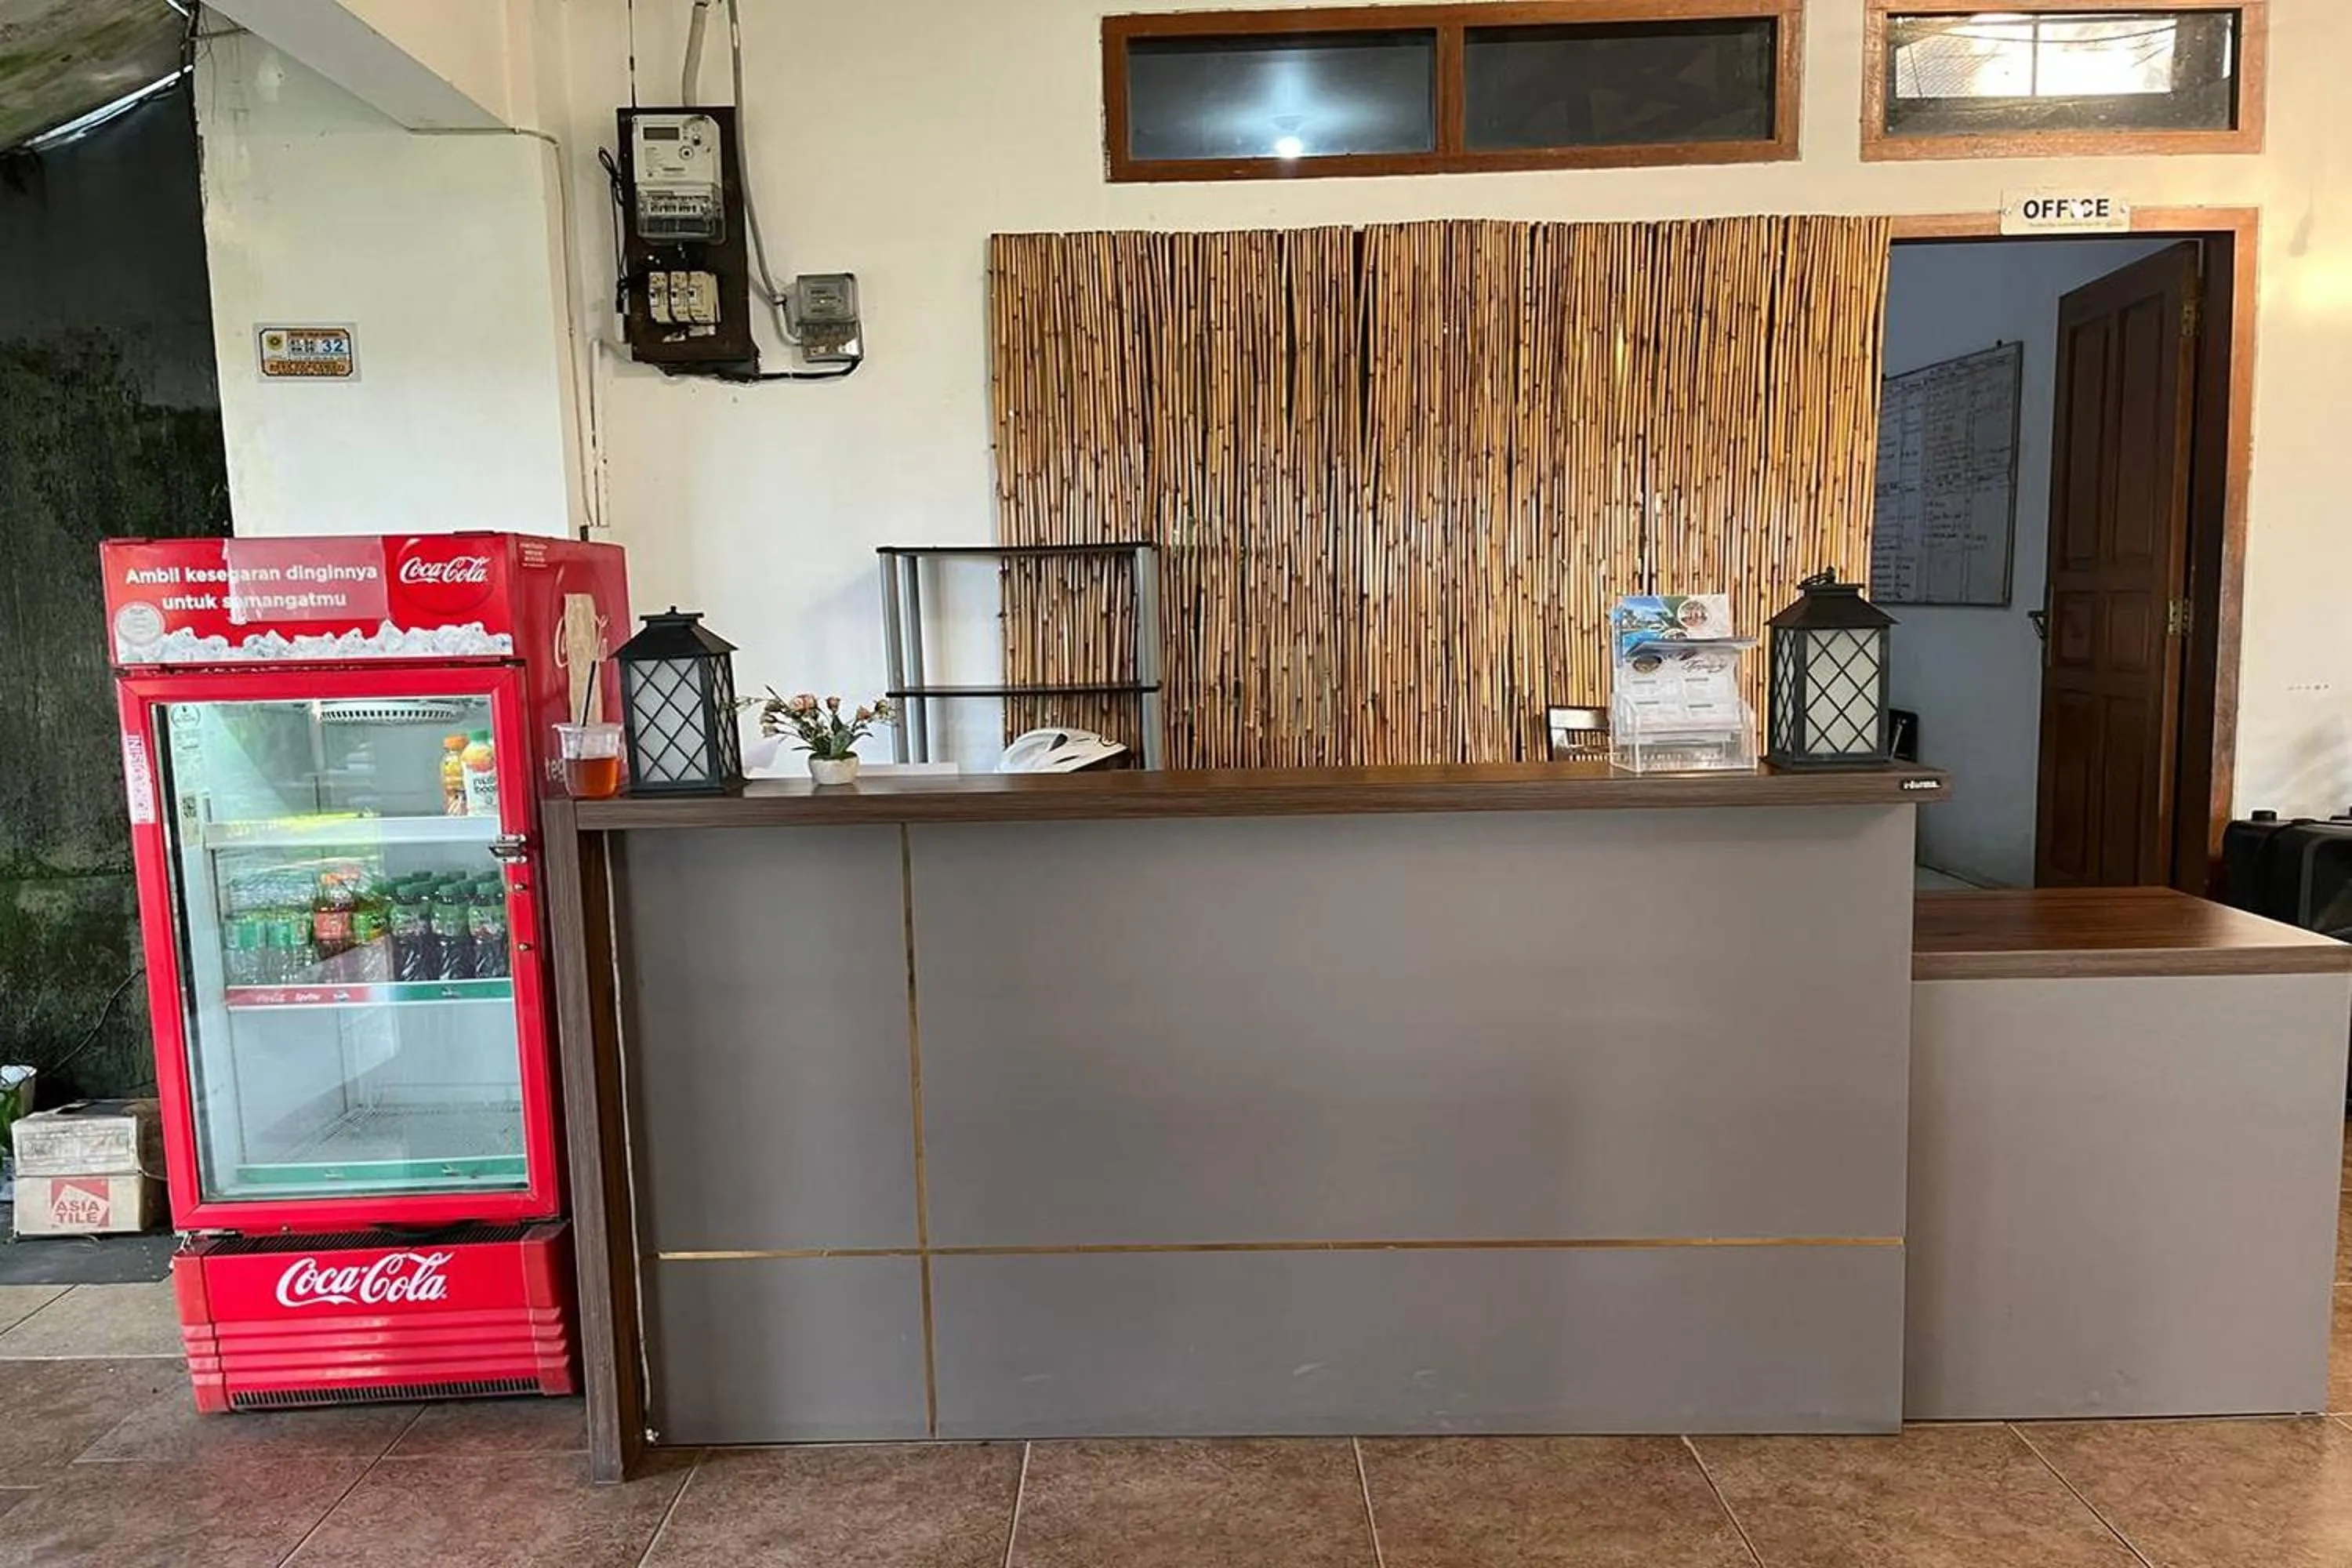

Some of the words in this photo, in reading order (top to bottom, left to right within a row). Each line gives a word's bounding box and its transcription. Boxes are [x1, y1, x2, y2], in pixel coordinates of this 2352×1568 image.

[2023, 198, 2110, 220] OFFCE
[321, 338, 344, 353] 32
[125, 567, 180, 584] Ambil
[286, 564, 378, 583] dinginnya
[400, 556, 491, 584] Coca-Cola
[162, 593, 218, 610] untuk
[222, 592, 347, 611] smangatmu
[55, 1200, 100, 1212] ASIA
[55, 1213, 98, 1225] TILE
[275, 1252, 455, 1308] Coca-Cola
